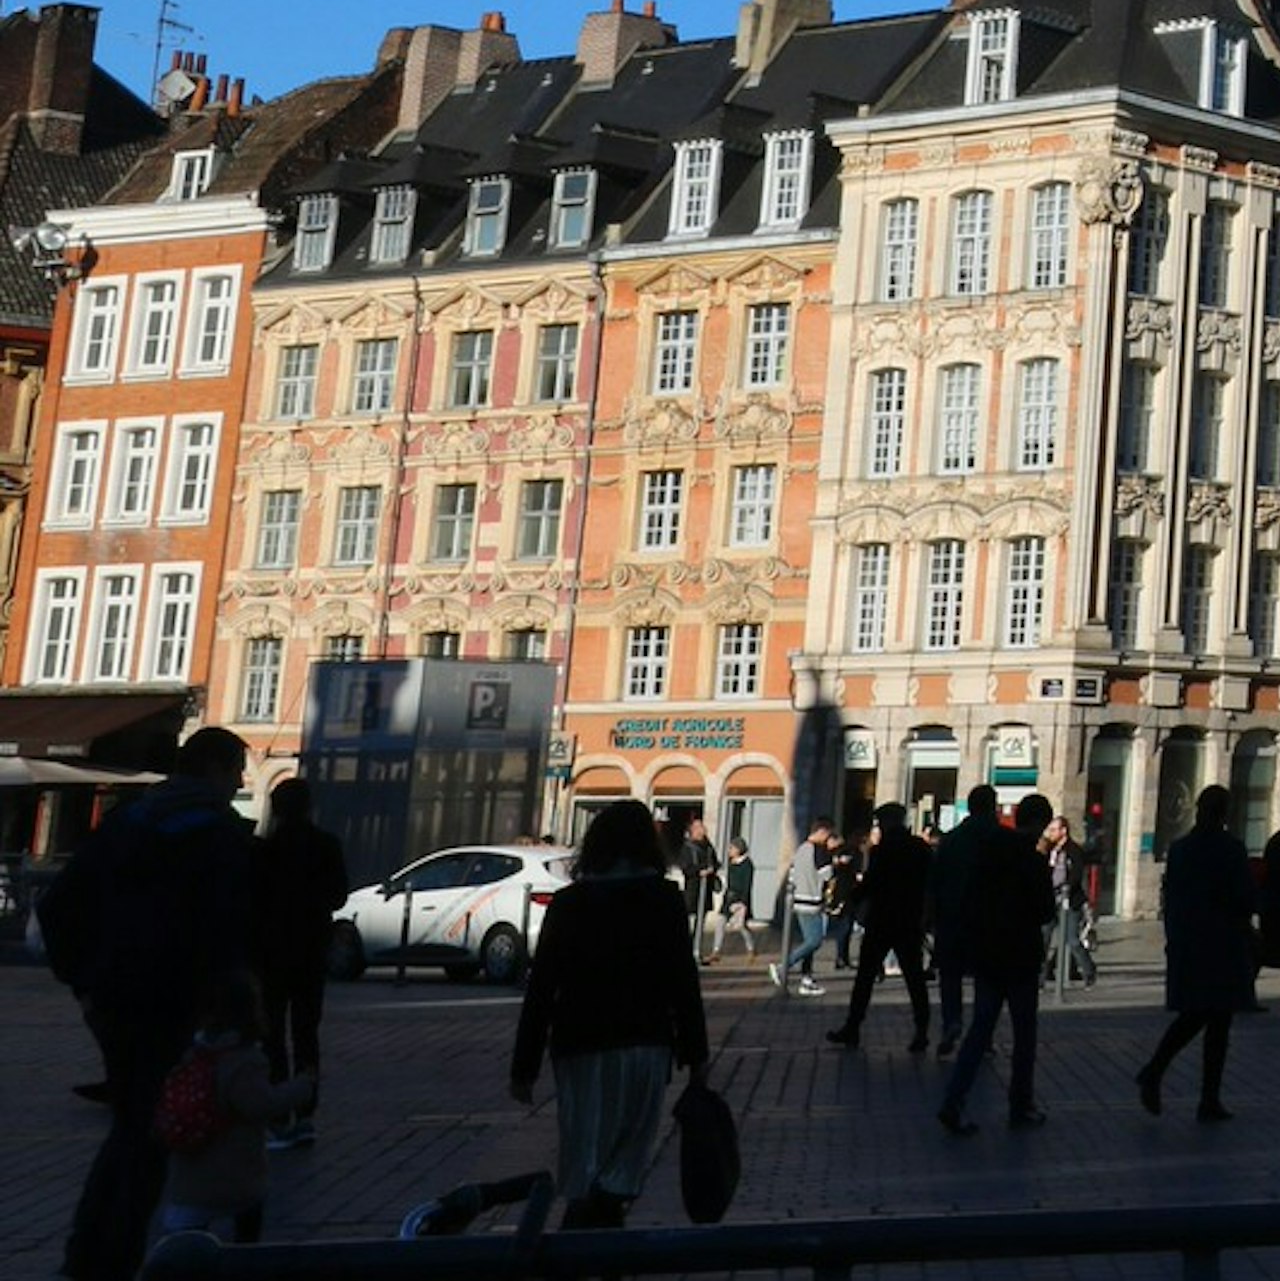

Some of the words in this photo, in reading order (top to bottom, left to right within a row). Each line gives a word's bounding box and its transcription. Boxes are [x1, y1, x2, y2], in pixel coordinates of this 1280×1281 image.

[672, 718, 744, 731] AGRICOLE
[660, 734, 680, 748] DE
[685, 734, 743, 748] FRANCE
